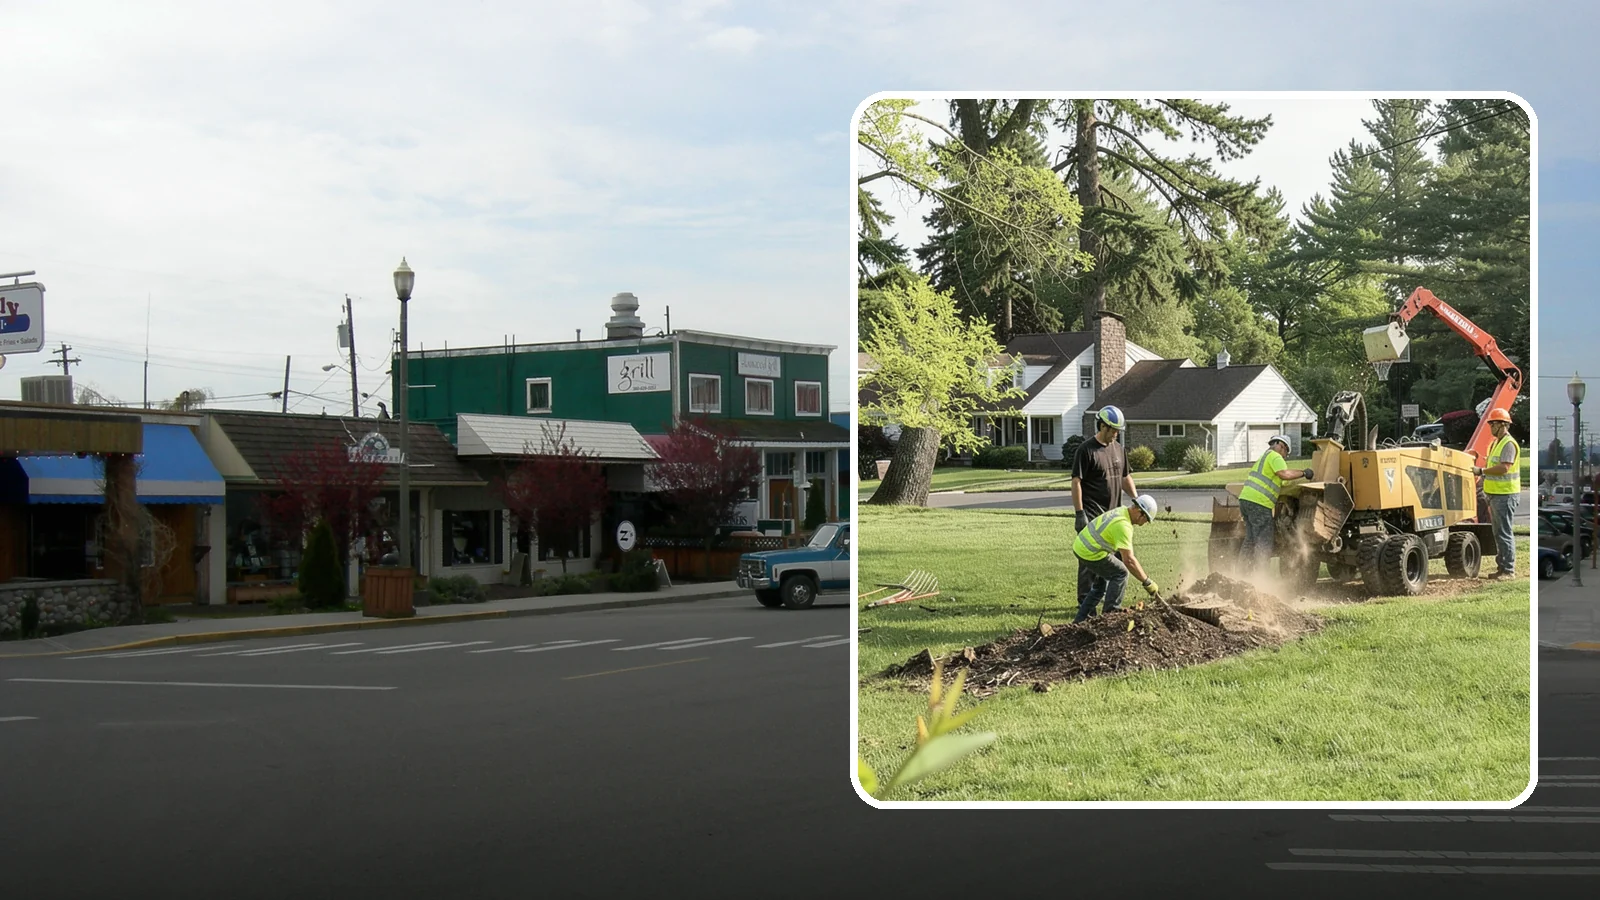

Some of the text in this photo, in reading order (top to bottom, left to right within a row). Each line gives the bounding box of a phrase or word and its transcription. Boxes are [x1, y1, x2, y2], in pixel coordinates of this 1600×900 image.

[3, 338, 16, 346] Fries
[20, 337, 38, 345] Salads
[618, 356, 655, 391] grill
[619, 529, 634, 542] Z's
